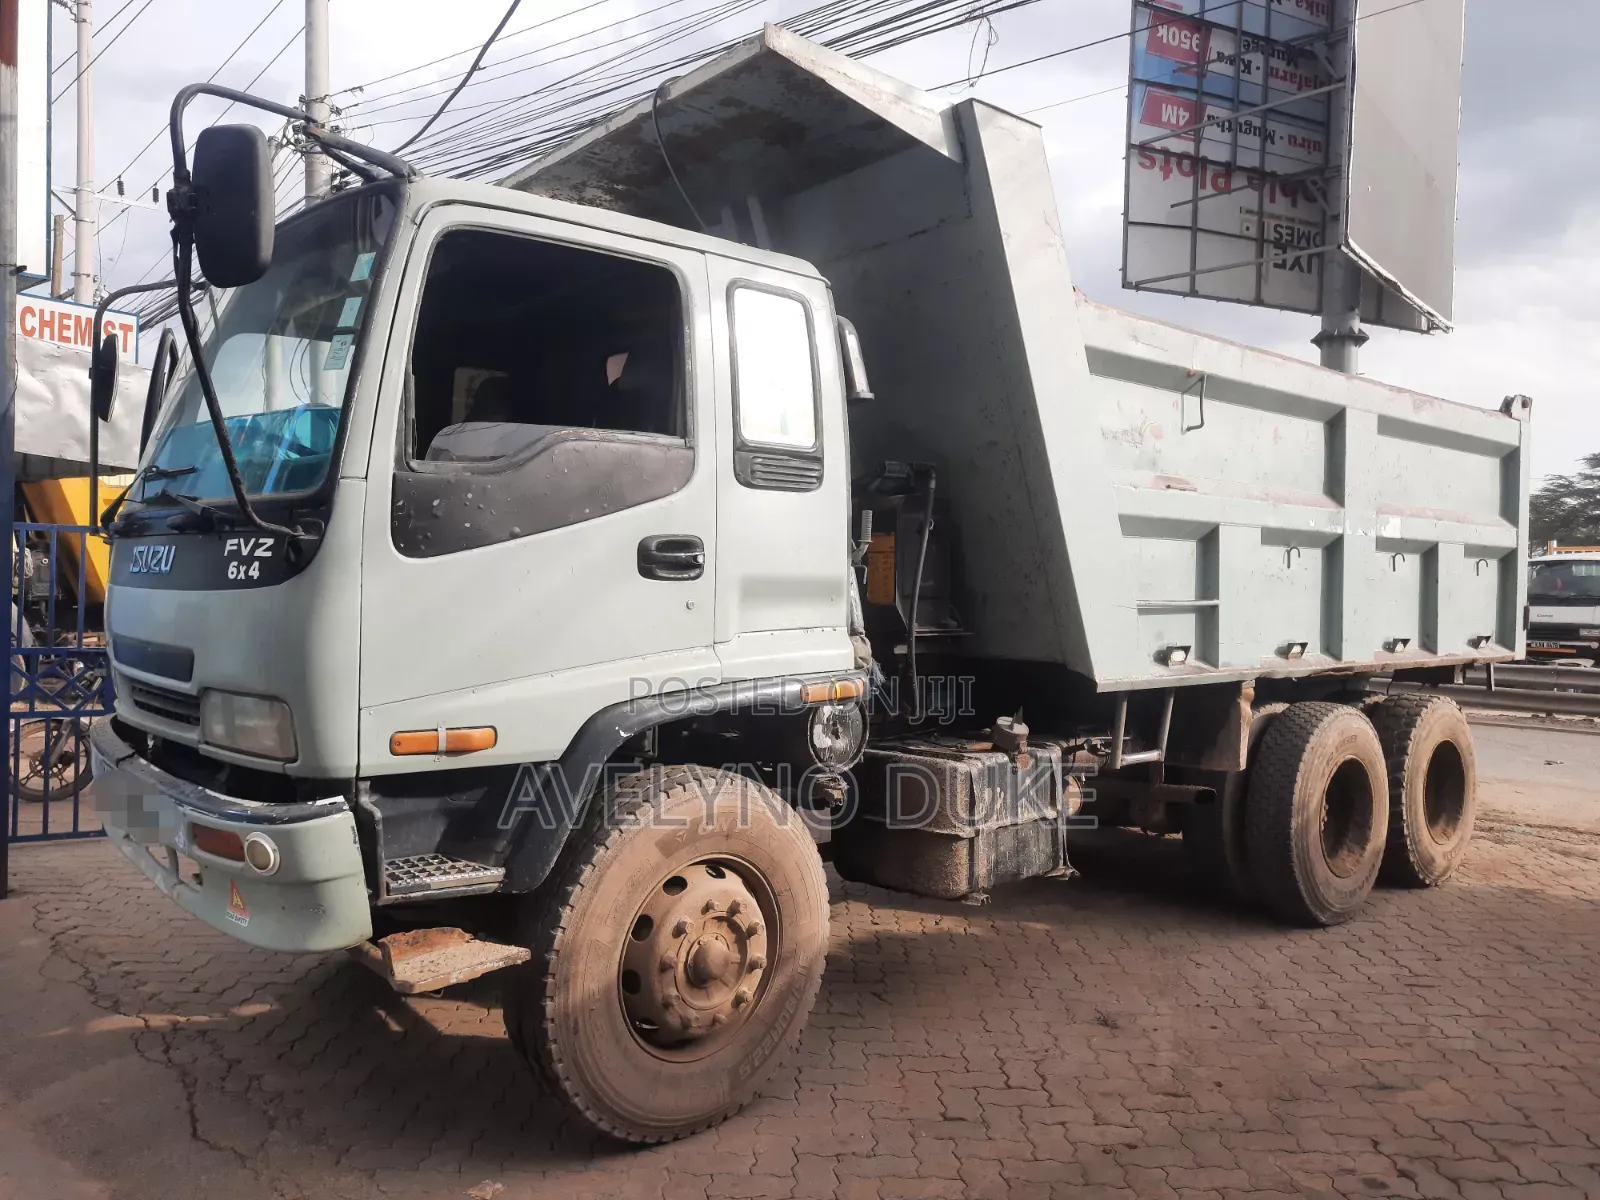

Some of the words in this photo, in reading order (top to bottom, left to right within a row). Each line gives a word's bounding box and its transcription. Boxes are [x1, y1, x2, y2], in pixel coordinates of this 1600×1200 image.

[1156, 24, 1200, 52] 950k
[1161, 103, 1190, 126] 4M
[1137, 144, 1232, 193] Plots
[20, 306, 133, 353] CHEMST
[130, 545, 176, 574] ISUZU
[224, 538, 275, 558] FVZ
[227, 561, 260, 580] 6x4
